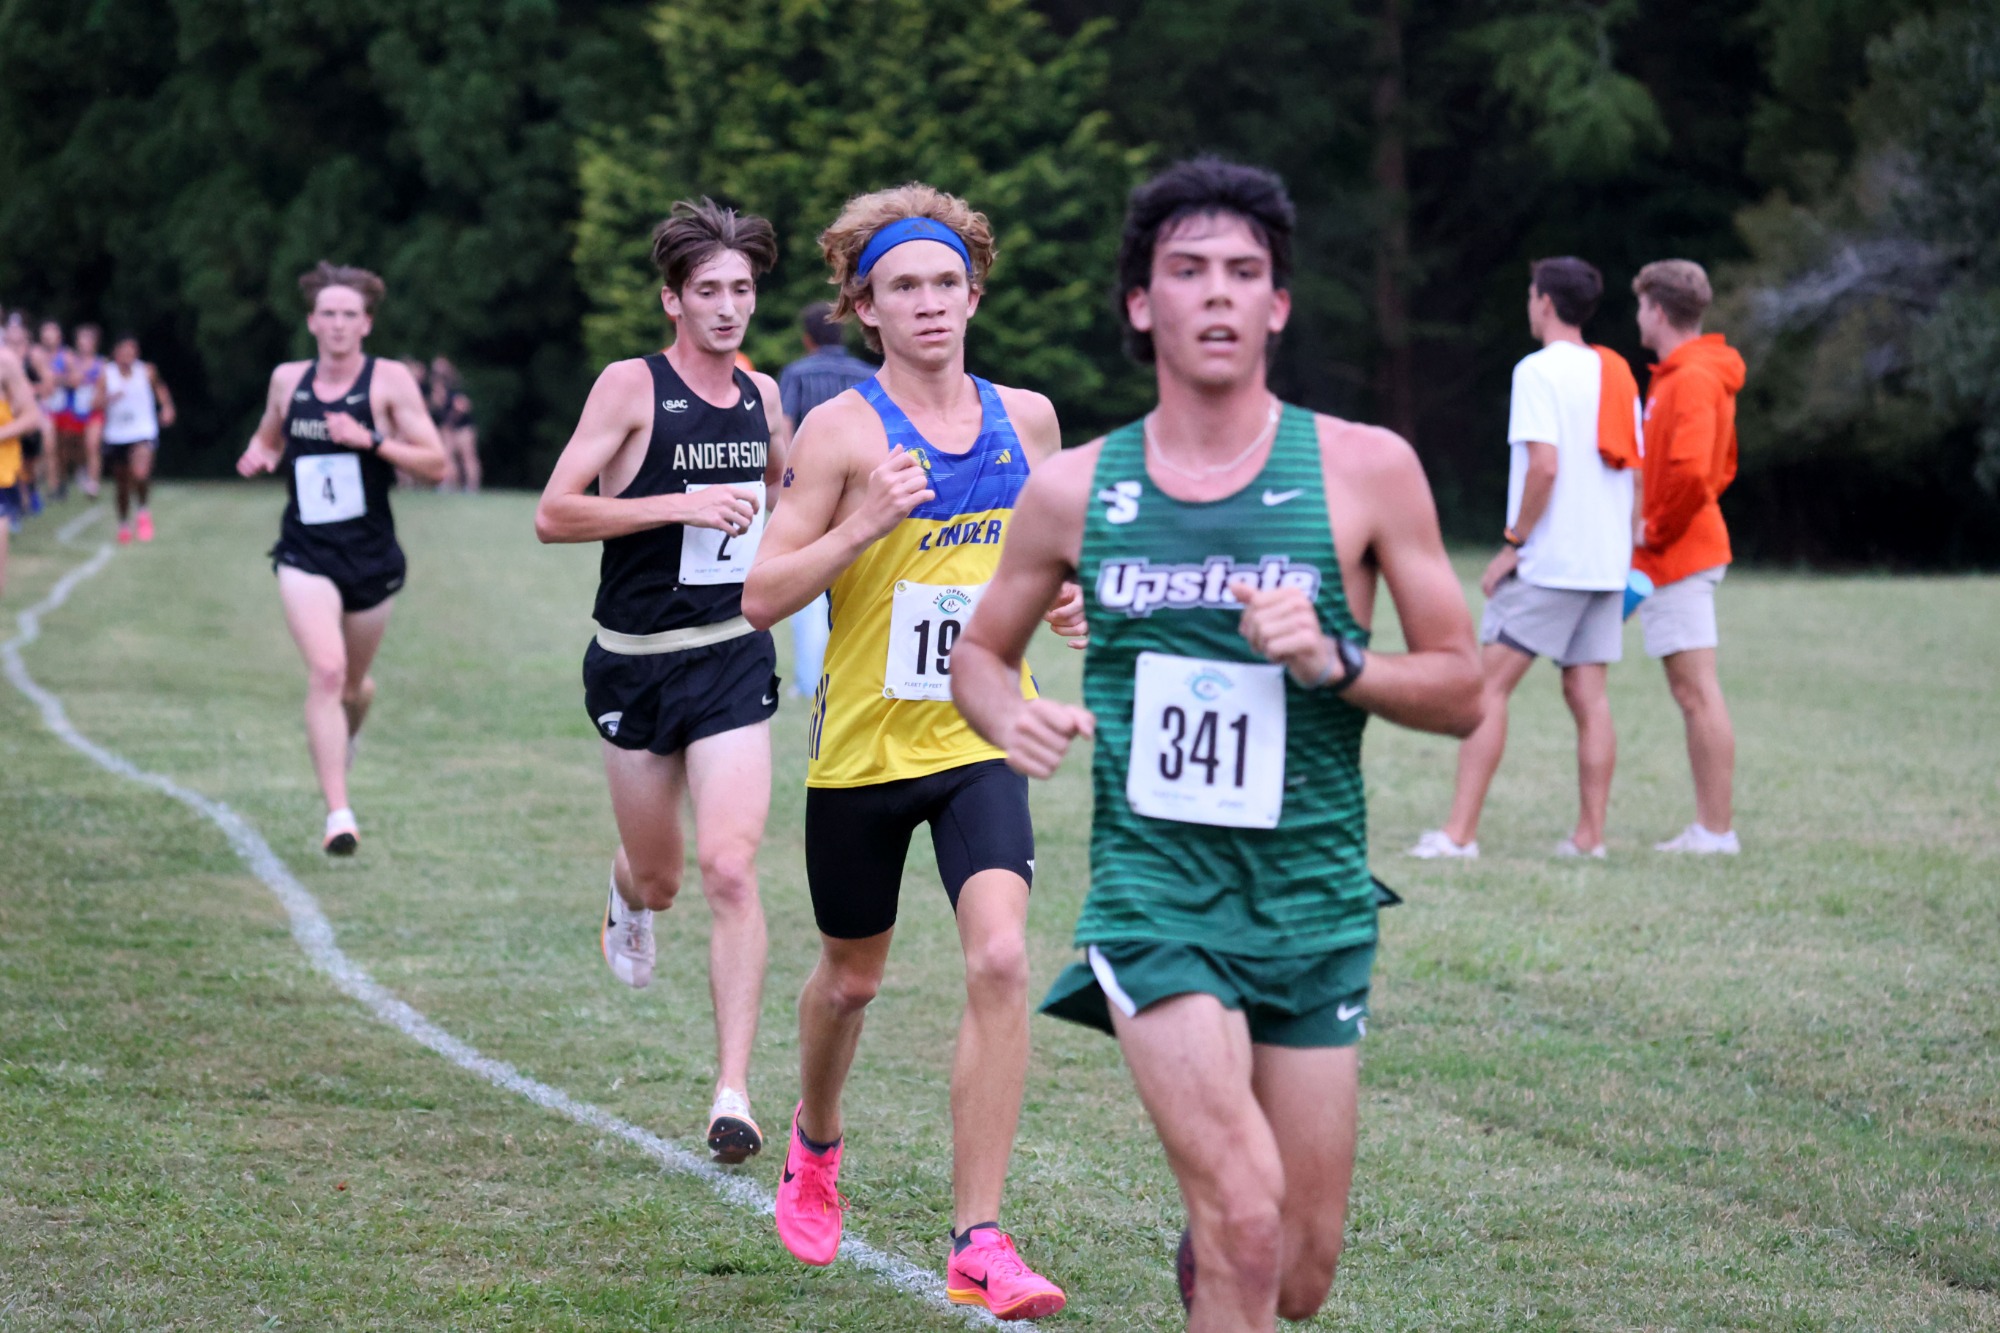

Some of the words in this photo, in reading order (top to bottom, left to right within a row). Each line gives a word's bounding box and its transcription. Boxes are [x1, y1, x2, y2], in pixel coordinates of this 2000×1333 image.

[664, 399, 688, 410] SAC
[673, 441, 767, 470] ANDERSON
[322, 476, 336, 505] 4
[945, 588, 972, 604] OPENER
[914, 619, 961, 675] 19
[1160, 706, 1248, 788] 341
